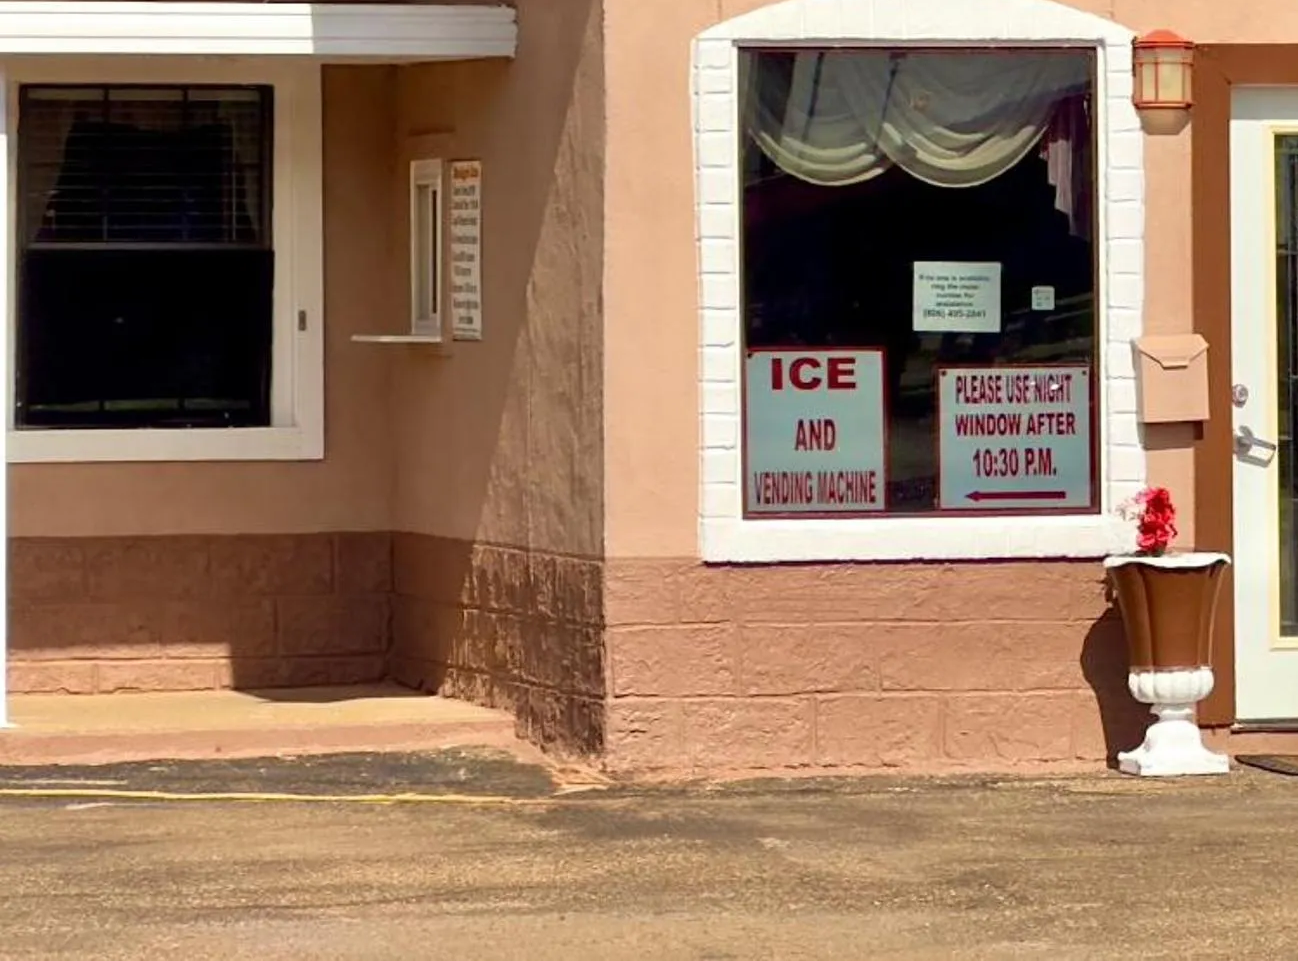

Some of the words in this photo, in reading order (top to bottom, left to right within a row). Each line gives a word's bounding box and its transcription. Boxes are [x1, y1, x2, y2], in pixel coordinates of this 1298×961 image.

[771, 357, 857, 390] ICE
[955, 375, 1002, 404] PLEASE
[1005, 375, 1030, 404] USE
[1034, 374, 1073, 403] NIGHT
[794, 418, 837, 451] AND
[955, 413, 1022, 436] WINDOW
[1026, 412, 1076, 435] AFTER
[972, 448, 1019, 477] 10:30
[1024, 447, 1057, 476] P.M.
[754, 471, 813, 504] VENDING
[817, 471, 877, 504] MACHINE
